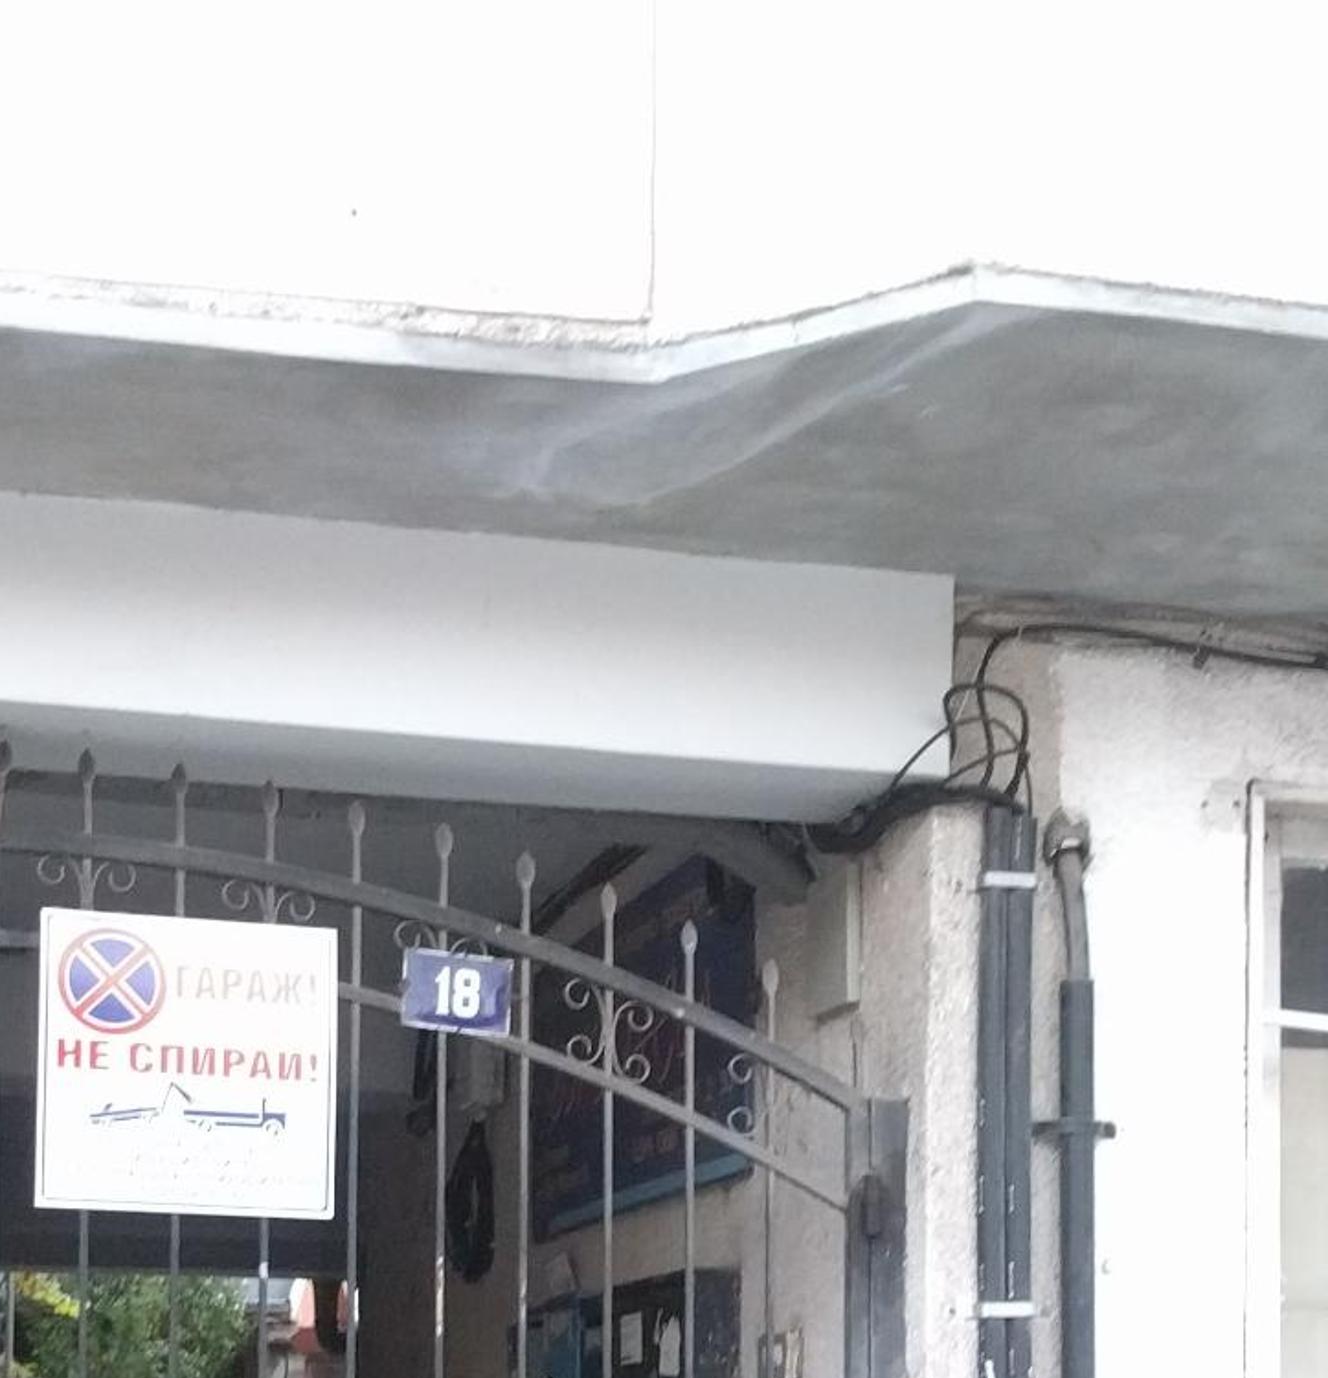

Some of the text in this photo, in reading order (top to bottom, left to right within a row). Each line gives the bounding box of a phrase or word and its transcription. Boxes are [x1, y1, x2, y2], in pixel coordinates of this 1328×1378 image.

[175, 964, 317, 1006] ГАРАЖ!
[434, 965, 481, 1019] 18
[56, 1038, 110, 1070] НЕ
